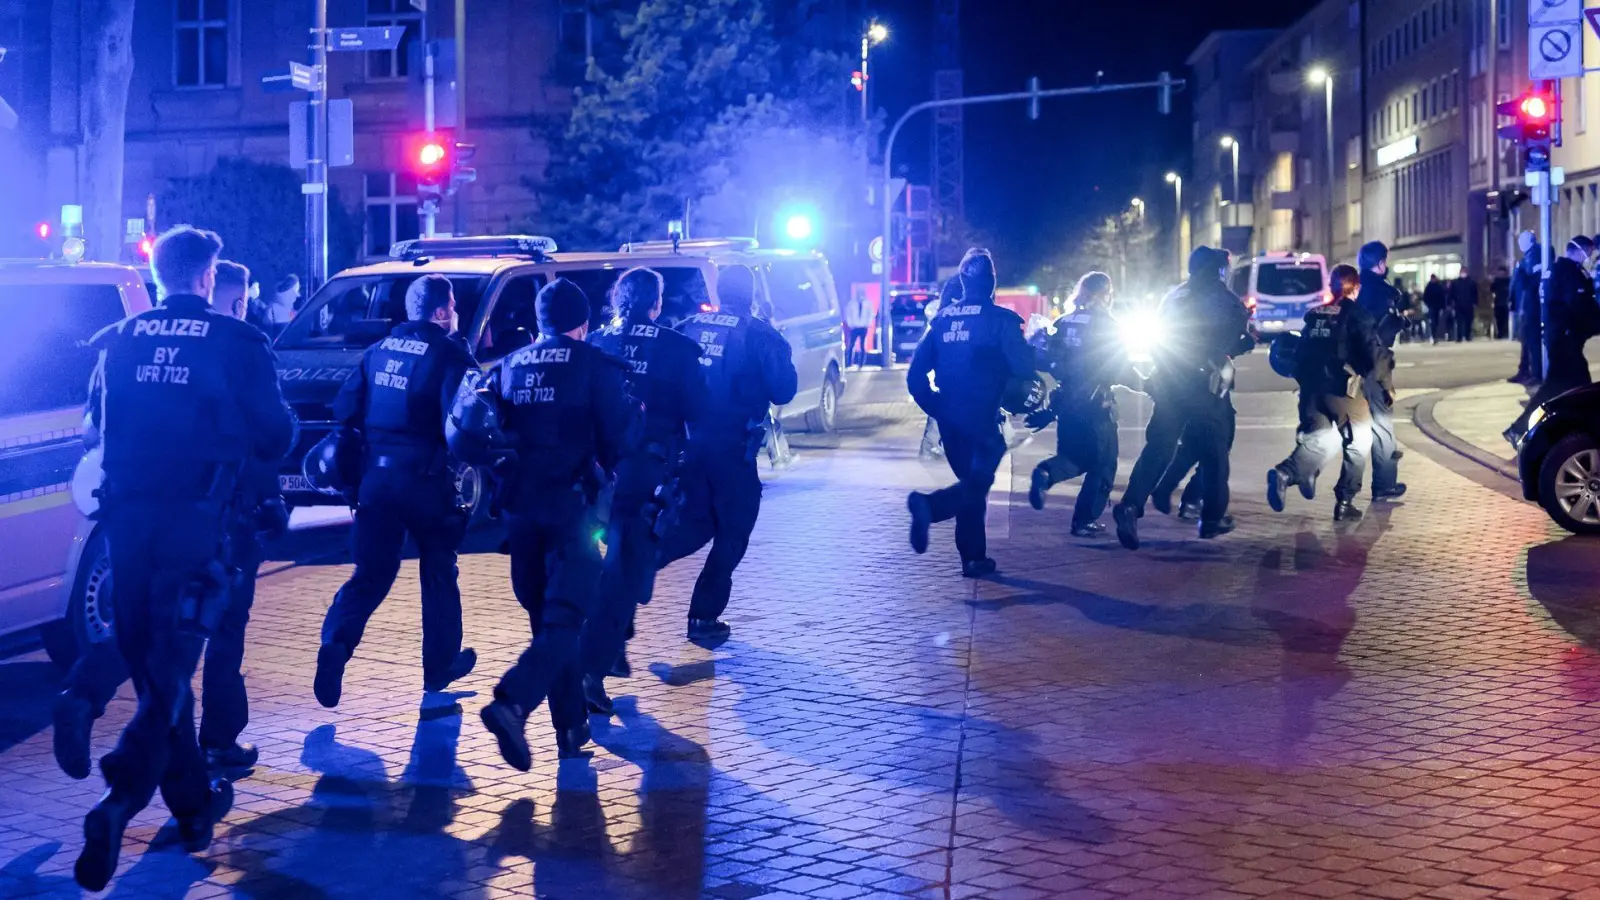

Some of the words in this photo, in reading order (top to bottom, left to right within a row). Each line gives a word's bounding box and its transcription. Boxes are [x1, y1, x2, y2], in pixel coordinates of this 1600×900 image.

[133, 319, 210, 337] POLIZEI
[692, 313, 740, 328] POLIZEI
[951, 320, 965, 332] BY
[603, 324, 660, 339] POIZEI
[700, 331, 718, 344] BY
[380, 338, 429, 356] POLIZEI
[153, 347, 180, 365] BY
[510, 347, 571, 368] POLIZEI
[136, 365, 161, 383] UFR
[162, 365, 190, 385] 7122
[276, 368, 356, 381] POLIZEI
[385, 359, 405, 374] BY
[525, 371, 545, 388] BY
[513, 389, 532, 406] UFR
[534, 387, 555, 403] 7122
